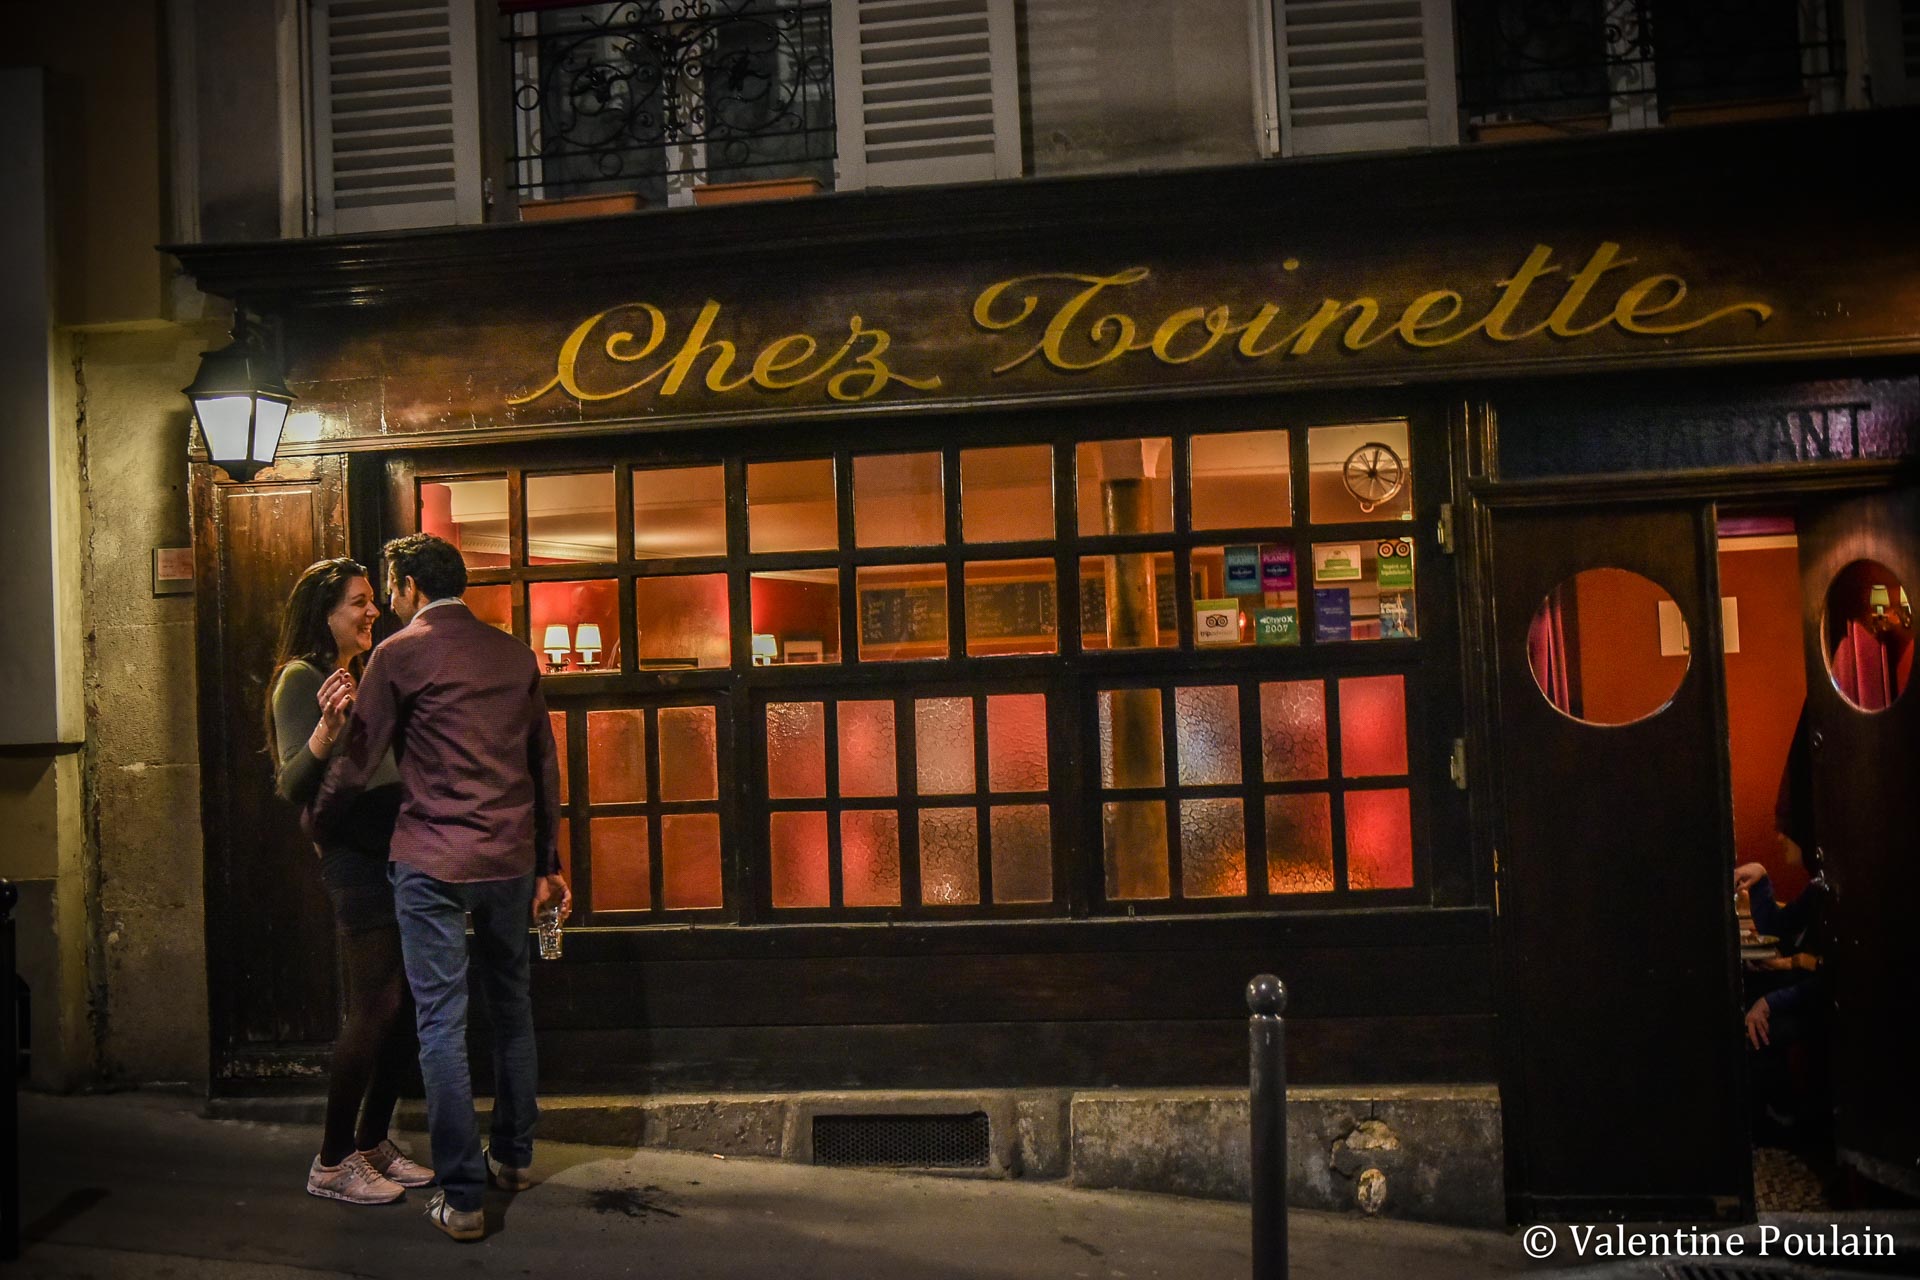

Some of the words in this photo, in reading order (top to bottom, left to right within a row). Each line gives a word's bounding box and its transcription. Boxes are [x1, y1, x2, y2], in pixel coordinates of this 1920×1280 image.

[507, 299, 943, 400] Chez
[971, 241, 1775, 374] Toinette
[1265, 624, 1289, 633] 2007
